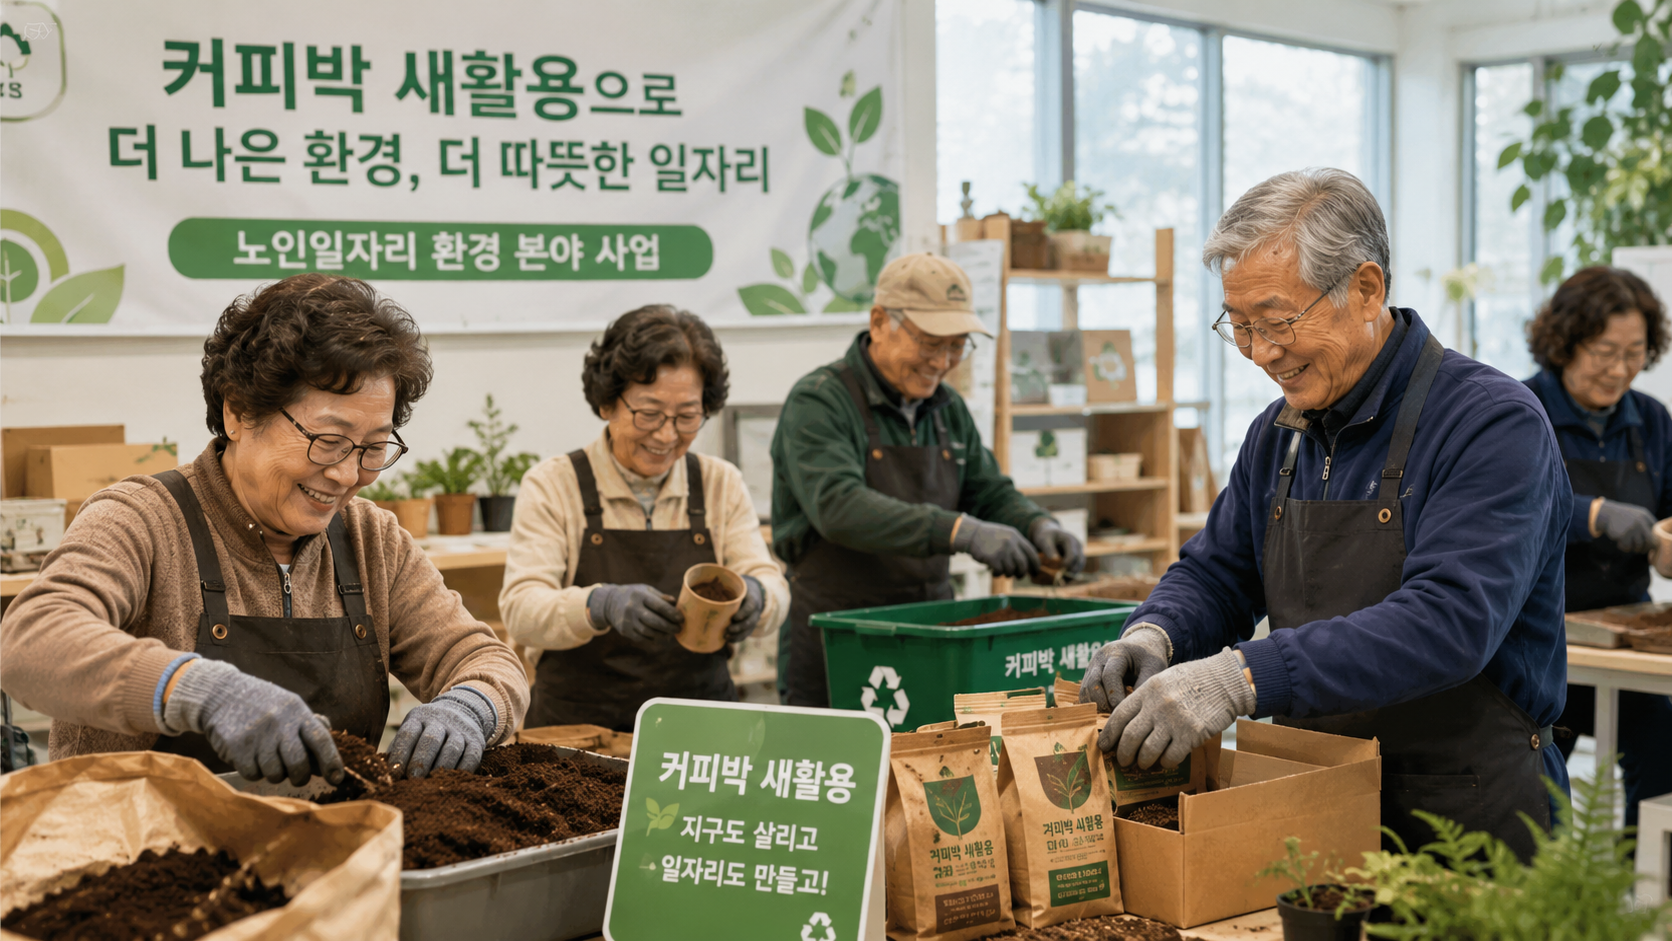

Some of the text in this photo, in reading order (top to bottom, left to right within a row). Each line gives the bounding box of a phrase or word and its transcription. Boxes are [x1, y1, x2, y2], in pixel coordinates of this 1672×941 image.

[163, 39, 681, 121] 커피박 새활용으로
[109, 125, 768, 192] 더 나은 환경, 더 따뜻한 일자리
[234, 230, 659, 271] 노인일자리 환경 본야 사업
[1005, 648, 1054, 678] 커피박
[659, 751, 856, 803] 커피박 새활용
[681, 816, 817, 851] 지구도 살리고
[662, 855, 828, 895] 일자리도 만들고!
